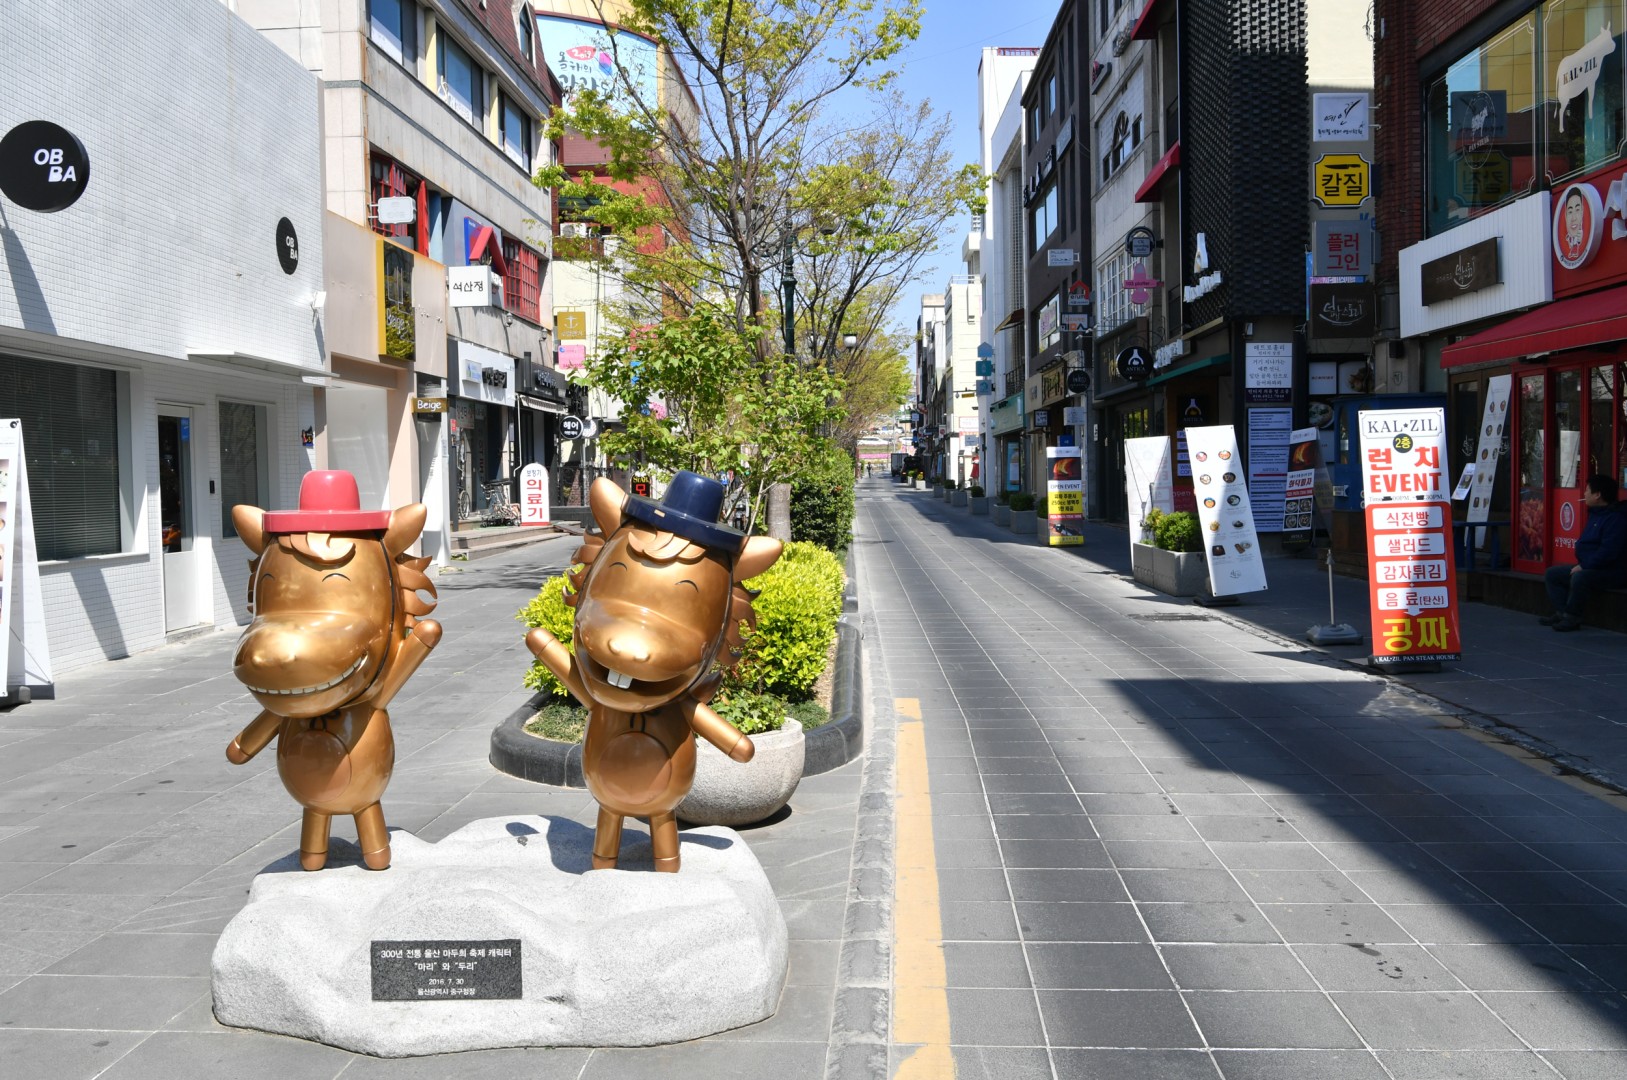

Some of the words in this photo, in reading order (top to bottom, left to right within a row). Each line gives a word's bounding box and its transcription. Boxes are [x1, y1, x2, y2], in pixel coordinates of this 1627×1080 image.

[558, 51, 592, 73] 올해의
[1563, 67, 1578, 86] KAL
[1583, 57, 1598, 74] ZIL
[33, 148, 64, 166] OB
[48, 165, 77, 183] BA
[1321, 172, 1363, 197] 칼질
[285, 236, 295, 248] OB
[1326, 233, 1360, 252] 플러
[290, 249, 298, 261] BA
[1327, 253, 1360, 271] 그인
[417, 400, 442, 412] Beige
[563, 421, 579, 430] 헤어
[1368, 420, 1403, 433] KAL
[1410, 419, 1438, 432] ZIL
[1394, 436, 1411, 449] 2층
[1369, 472, 1442, 493] EVENT
[526, 479, 543, 519] 의료기
[1386, 511, 1430, 527] 식전빵
[1388, 538, 1431, 553] 샐러드
[1384, 564, 1441, 581] 감자튀김
[1382, 616, 1449, 652] 공짜
[380, 949, 403, 959] 300년
[406, 949, 421, 959] 전통
[424, 949, 440, 958] 울산
[443, 949, 467, 958] 마두희
[469, 949, 485, 958] 축제
[488, 948, 512, 957] 캐릭터
[442, 963, 450, 971] 와
[417, 988, 449, 996] 울산광역시
